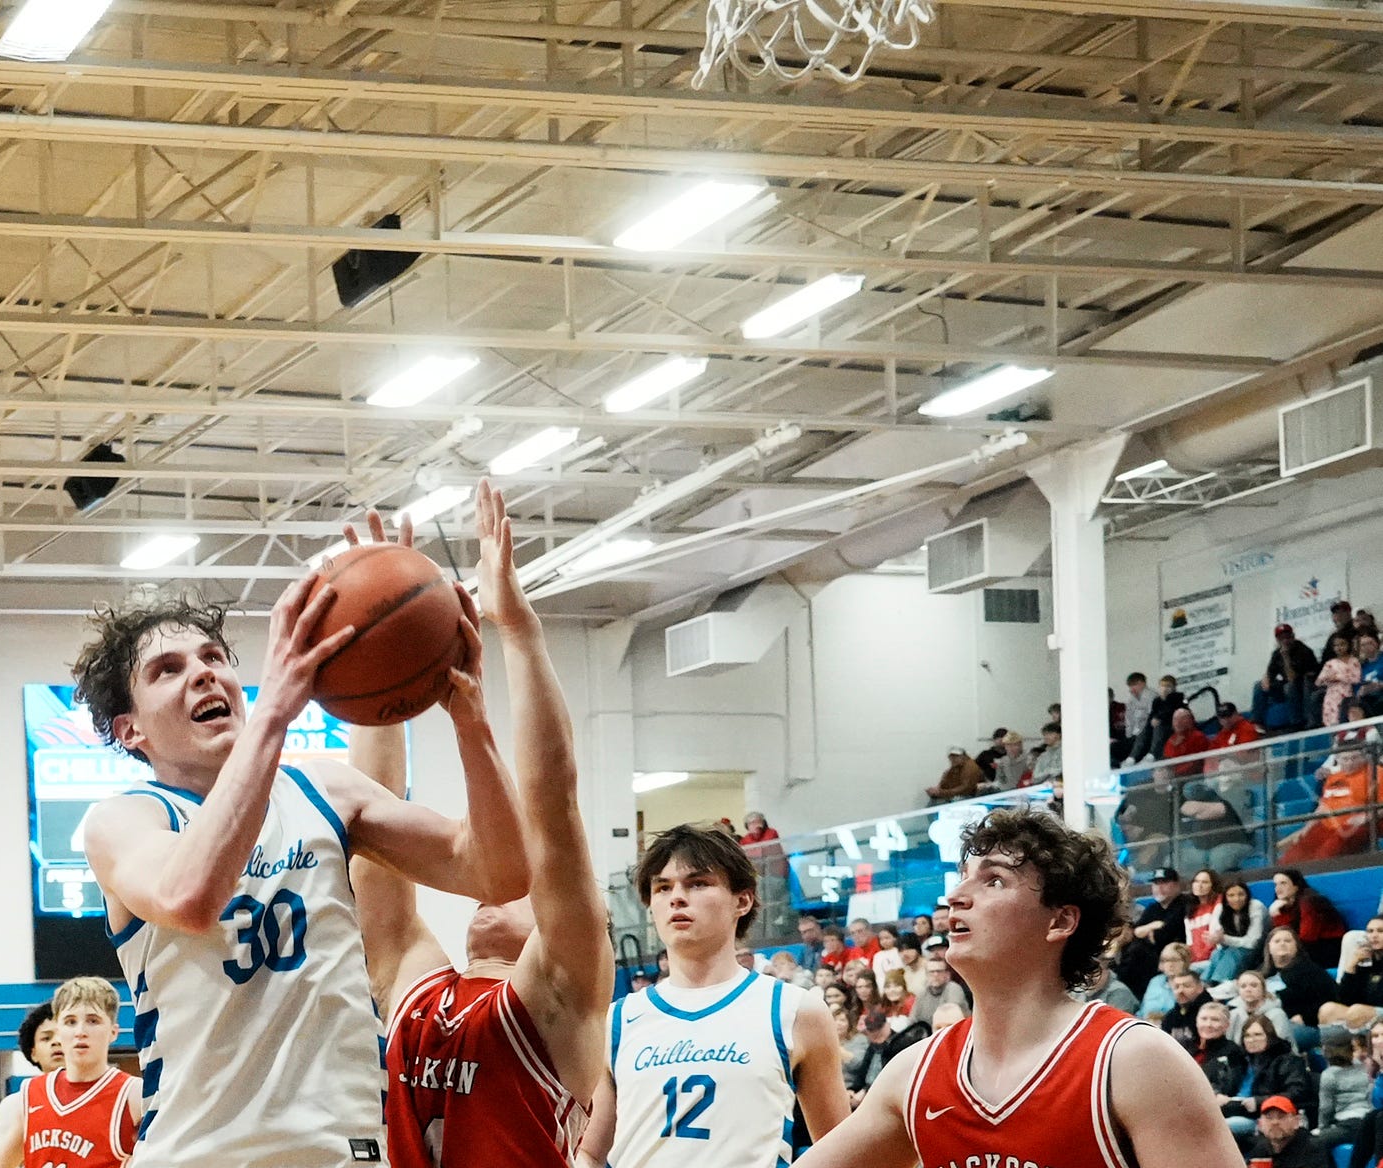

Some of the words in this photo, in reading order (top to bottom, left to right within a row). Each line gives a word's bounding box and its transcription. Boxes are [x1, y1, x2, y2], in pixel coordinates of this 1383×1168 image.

[241, 840, 318, 879] licothe
[219, 888, 307, 985] 30
[634, 1039, 751, 1072] Chillicothe
[660, 1074, 717, 1140] 12
[29, 1128, 94, 1160] JACKSON
